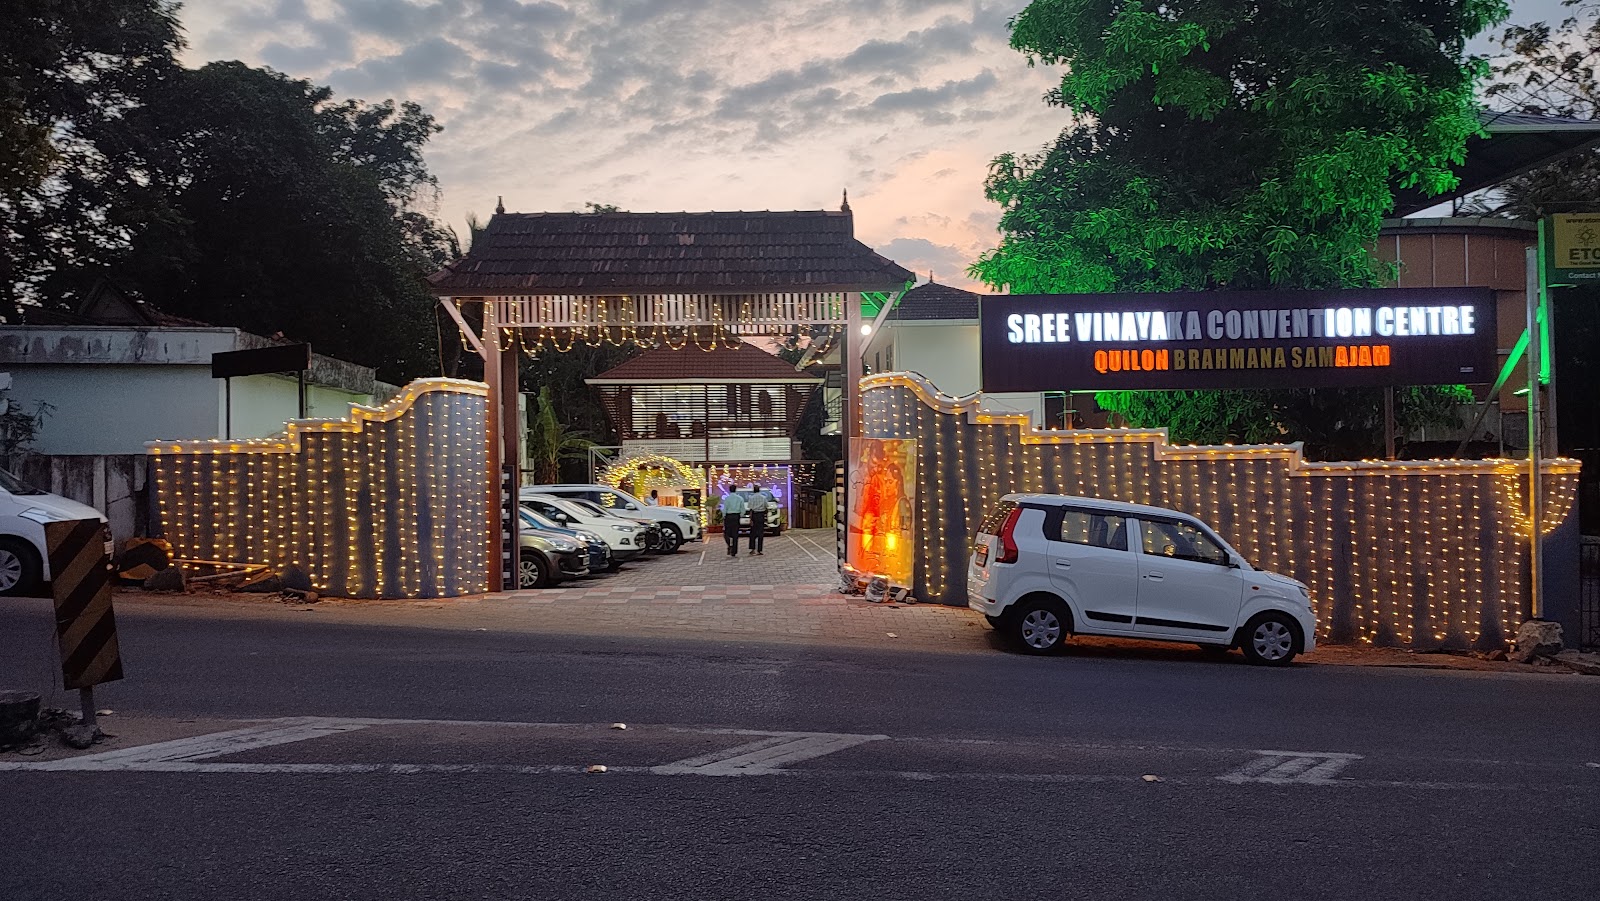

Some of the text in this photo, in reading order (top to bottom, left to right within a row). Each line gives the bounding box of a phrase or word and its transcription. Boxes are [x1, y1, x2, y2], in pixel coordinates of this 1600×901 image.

[1007, 306, 1475, 343] SREE VINAYAKA CONVENTION CENTRE
[1094, 345, 1390, 374] QUILON BRAHMANA SAMAJAM
